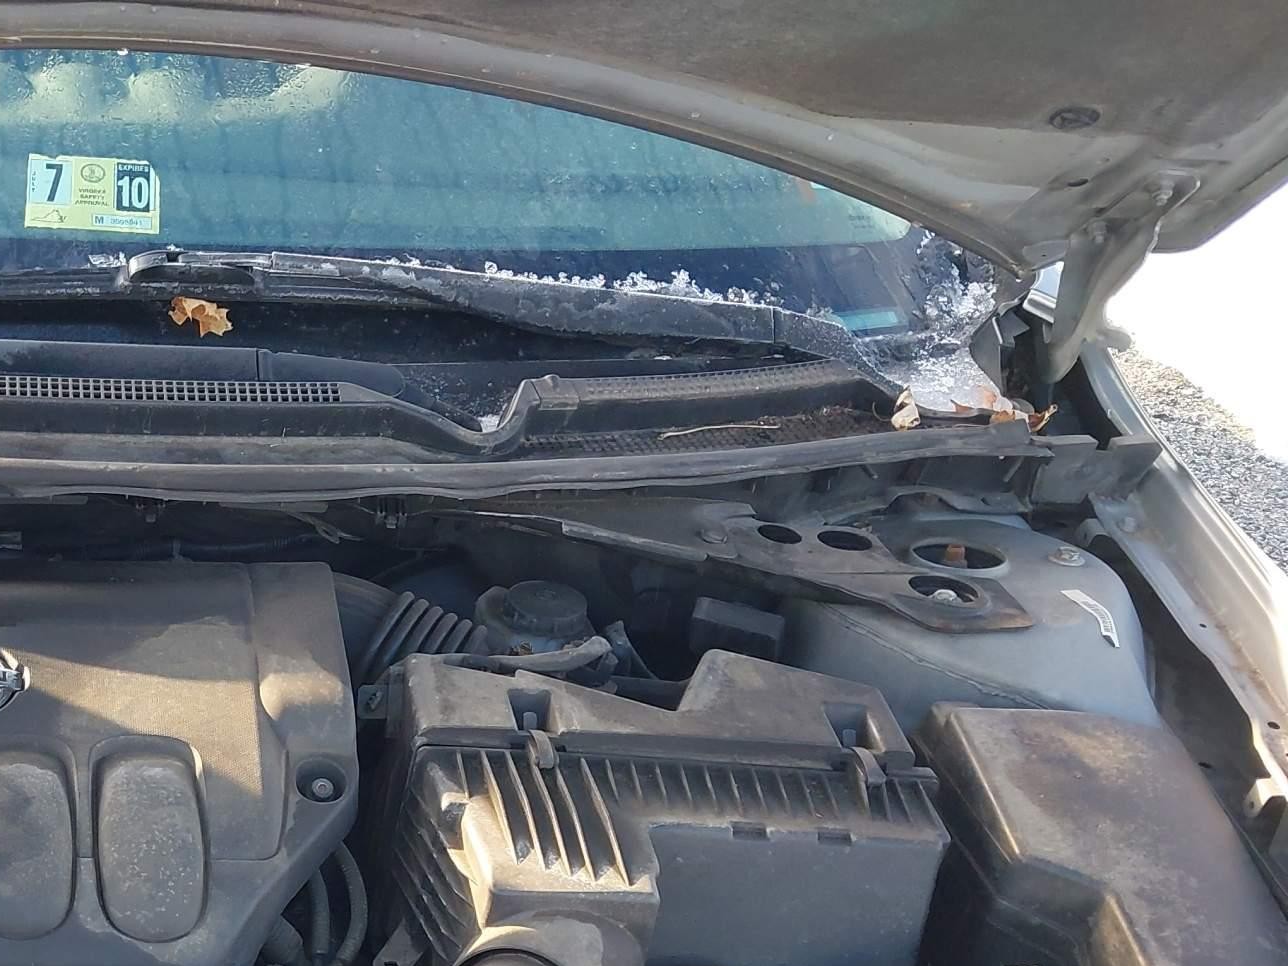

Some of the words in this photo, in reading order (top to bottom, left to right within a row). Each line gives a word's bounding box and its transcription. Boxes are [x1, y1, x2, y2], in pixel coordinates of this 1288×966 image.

[45, 163, 64, 202] 7
[117, 176, 150, 209] 10
[94, 215, 104, 225] M
